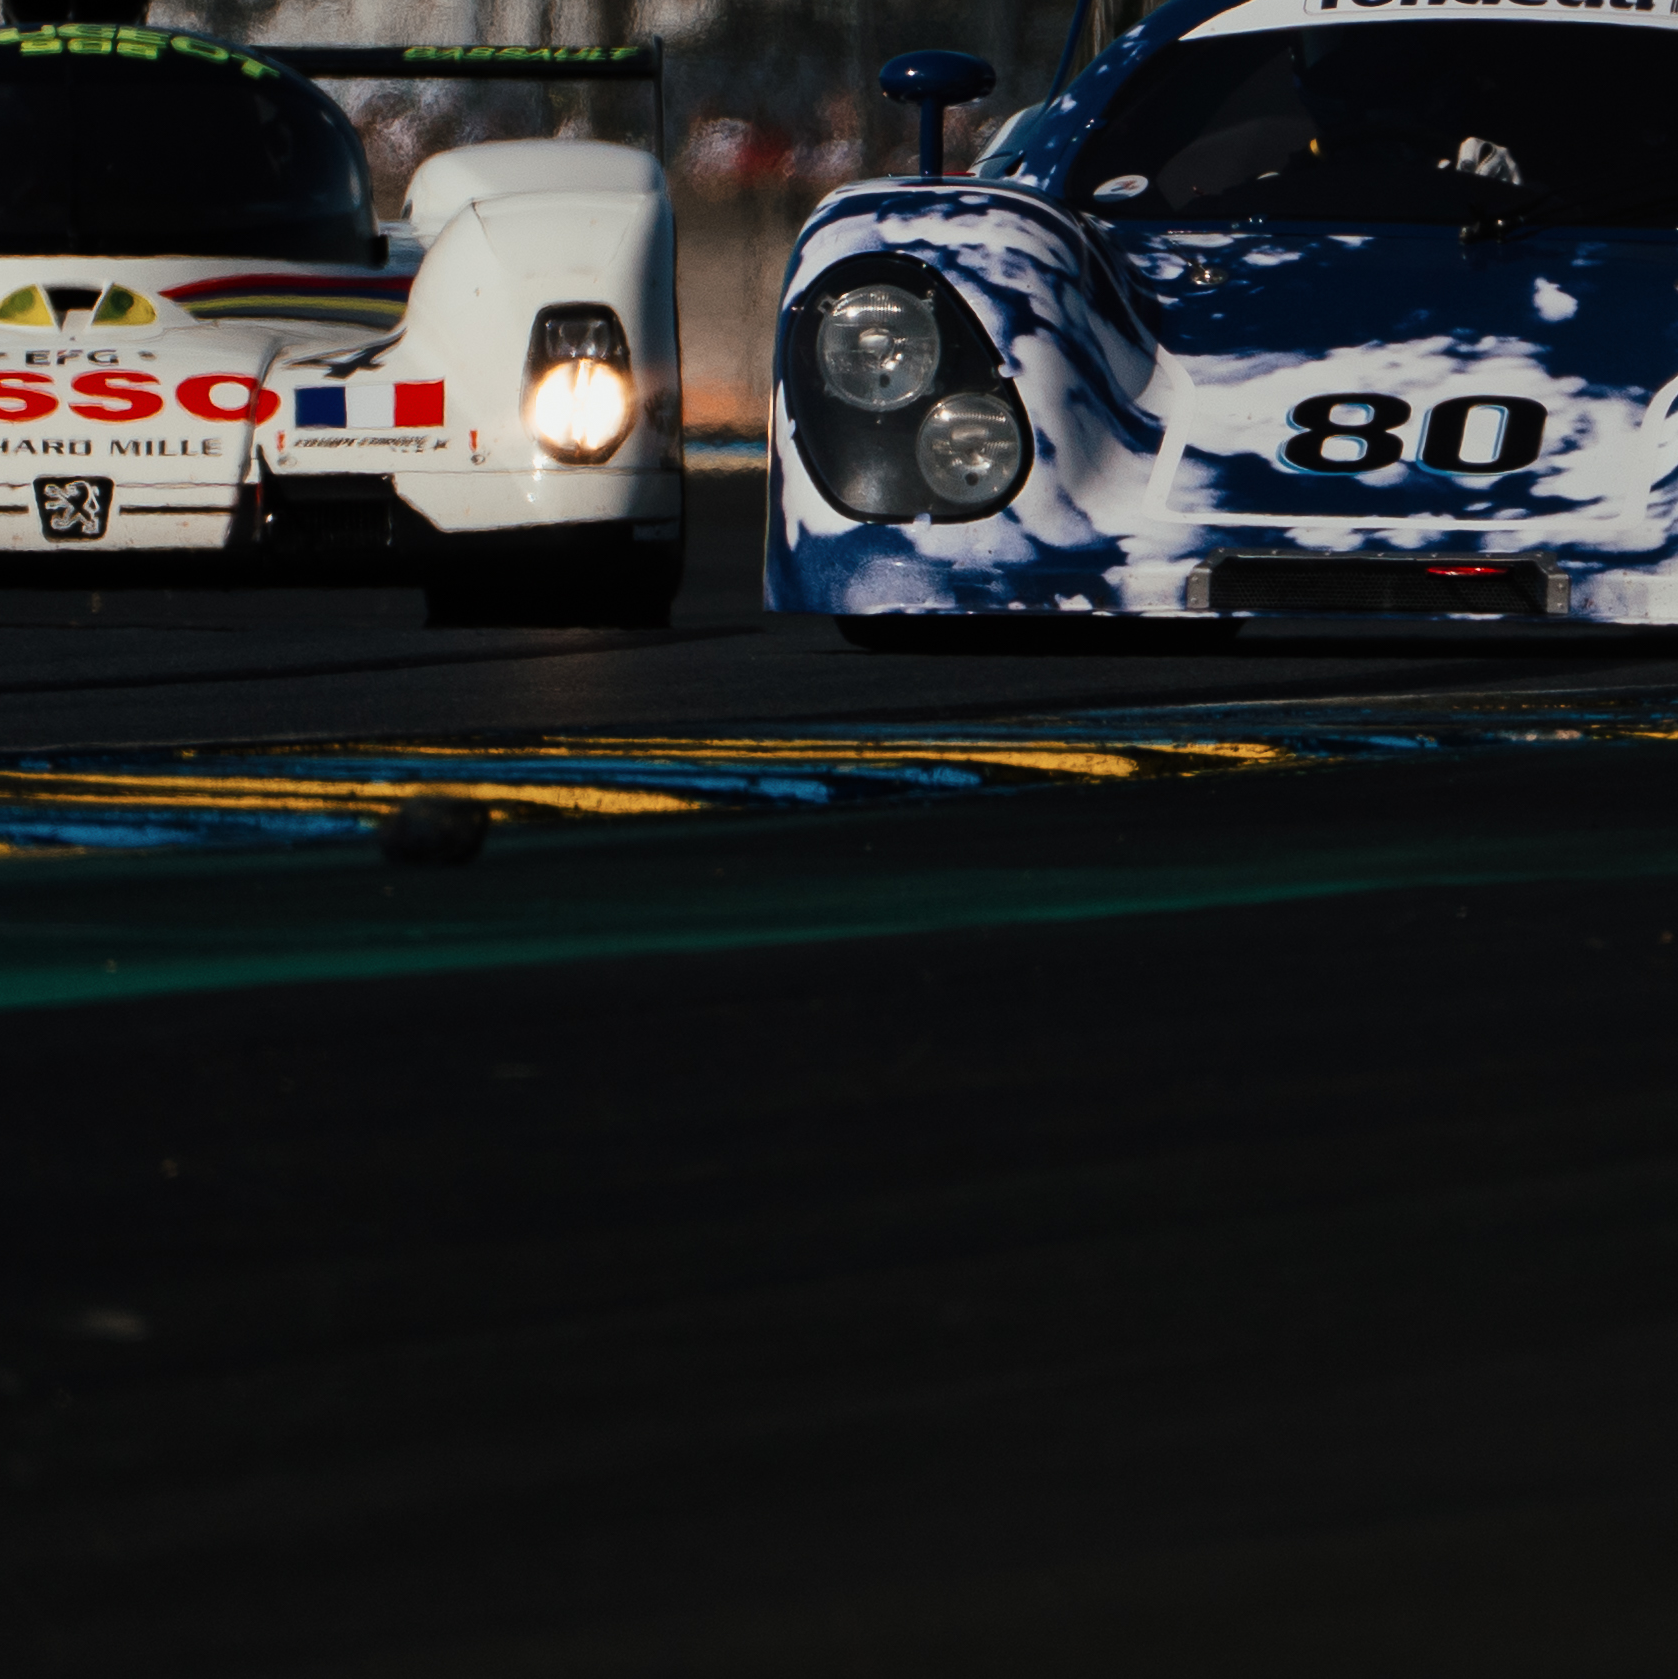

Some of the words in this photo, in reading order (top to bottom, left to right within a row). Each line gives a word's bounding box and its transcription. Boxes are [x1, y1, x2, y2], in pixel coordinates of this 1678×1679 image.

[25, 348, 120, 366] EFG
[1276, 392, 1548, 476] 80
[109, 437, 224, 457] MILLE
